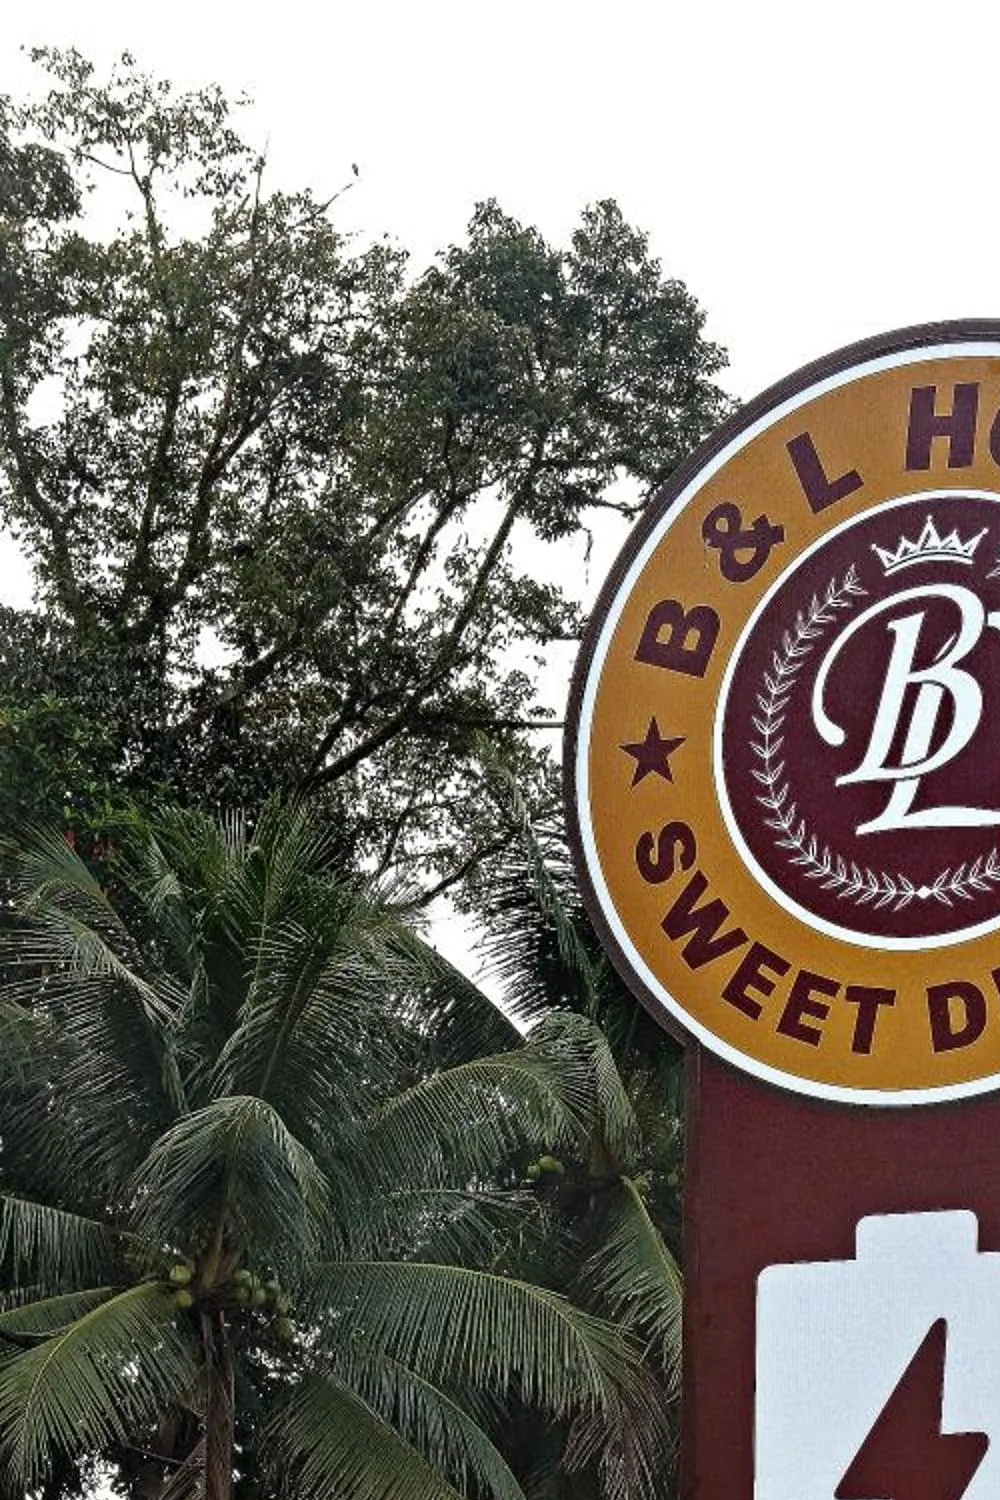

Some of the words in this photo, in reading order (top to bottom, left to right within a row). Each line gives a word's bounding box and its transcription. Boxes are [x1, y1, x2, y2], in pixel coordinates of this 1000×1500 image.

[633, 597, 720, 679] B
[701, 500, 786, 583] &
[786, 430, 864, 514] L
[635, 820, 895, 1055] SWEET
